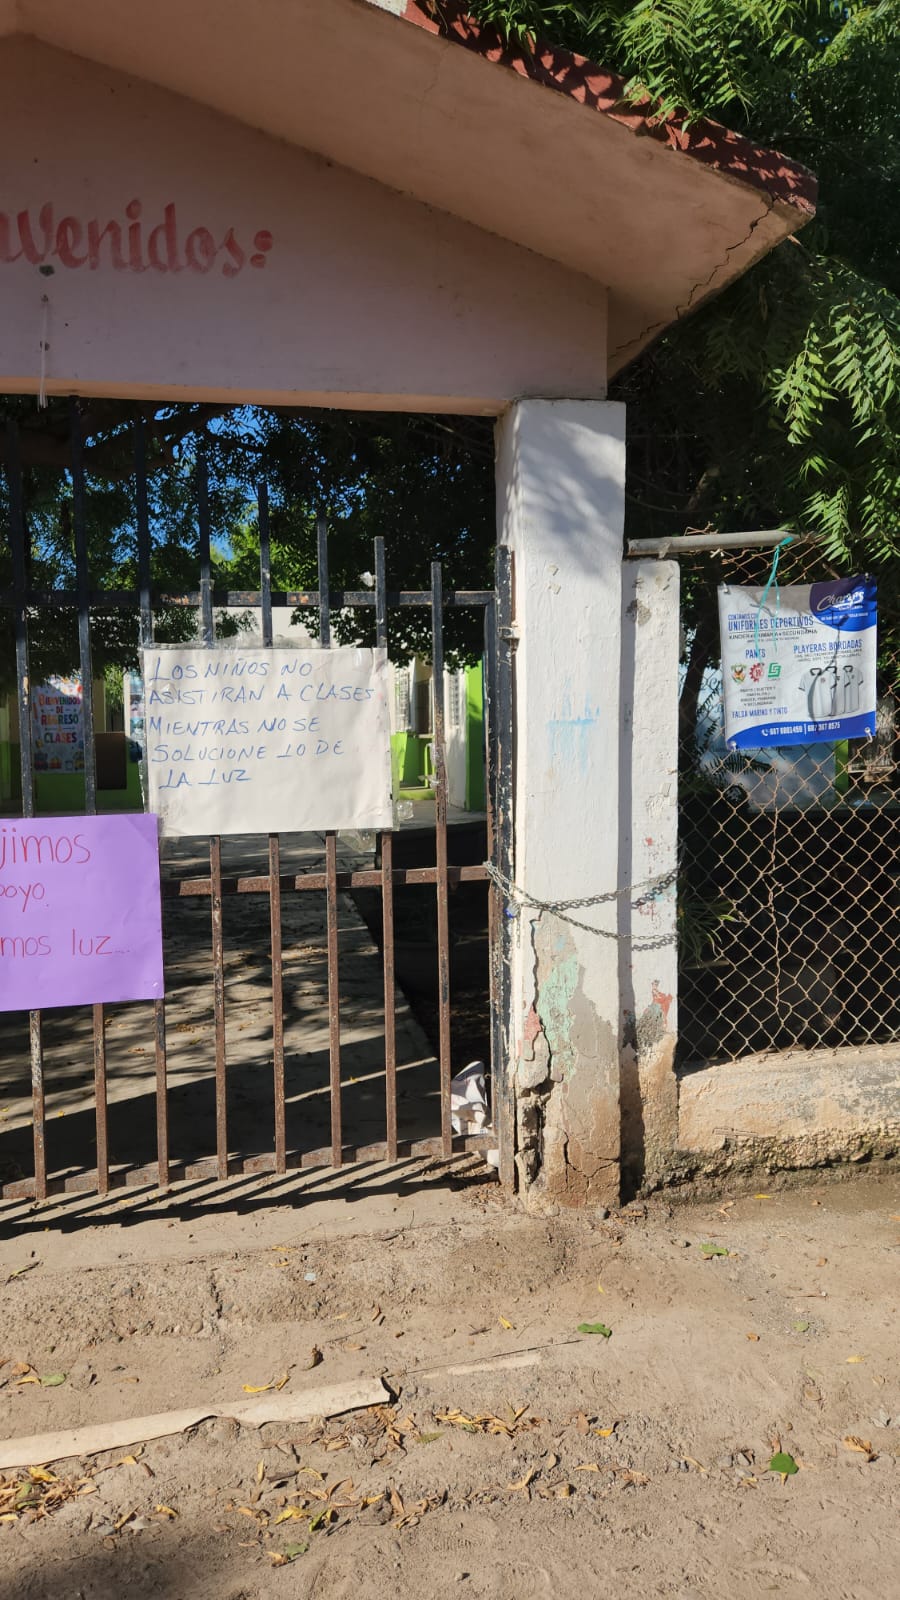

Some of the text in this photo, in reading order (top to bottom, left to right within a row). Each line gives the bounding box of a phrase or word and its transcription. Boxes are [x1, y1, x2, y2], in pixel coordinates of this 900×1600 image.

[793, 642, 827, 654] PLAYERAS
[150, 657, 313, 681] LOS NIÑOS NO
[277, 682, 292, 701] A
[300, 681, 375, 701] CLASES
[150, 717, 321, 737] MIENTRAS NO SE
[44, 732, 77, 744] CLASES
[152, 744, 266, 763] SOLUCIONE
[315, 740, 345, 756] DE
